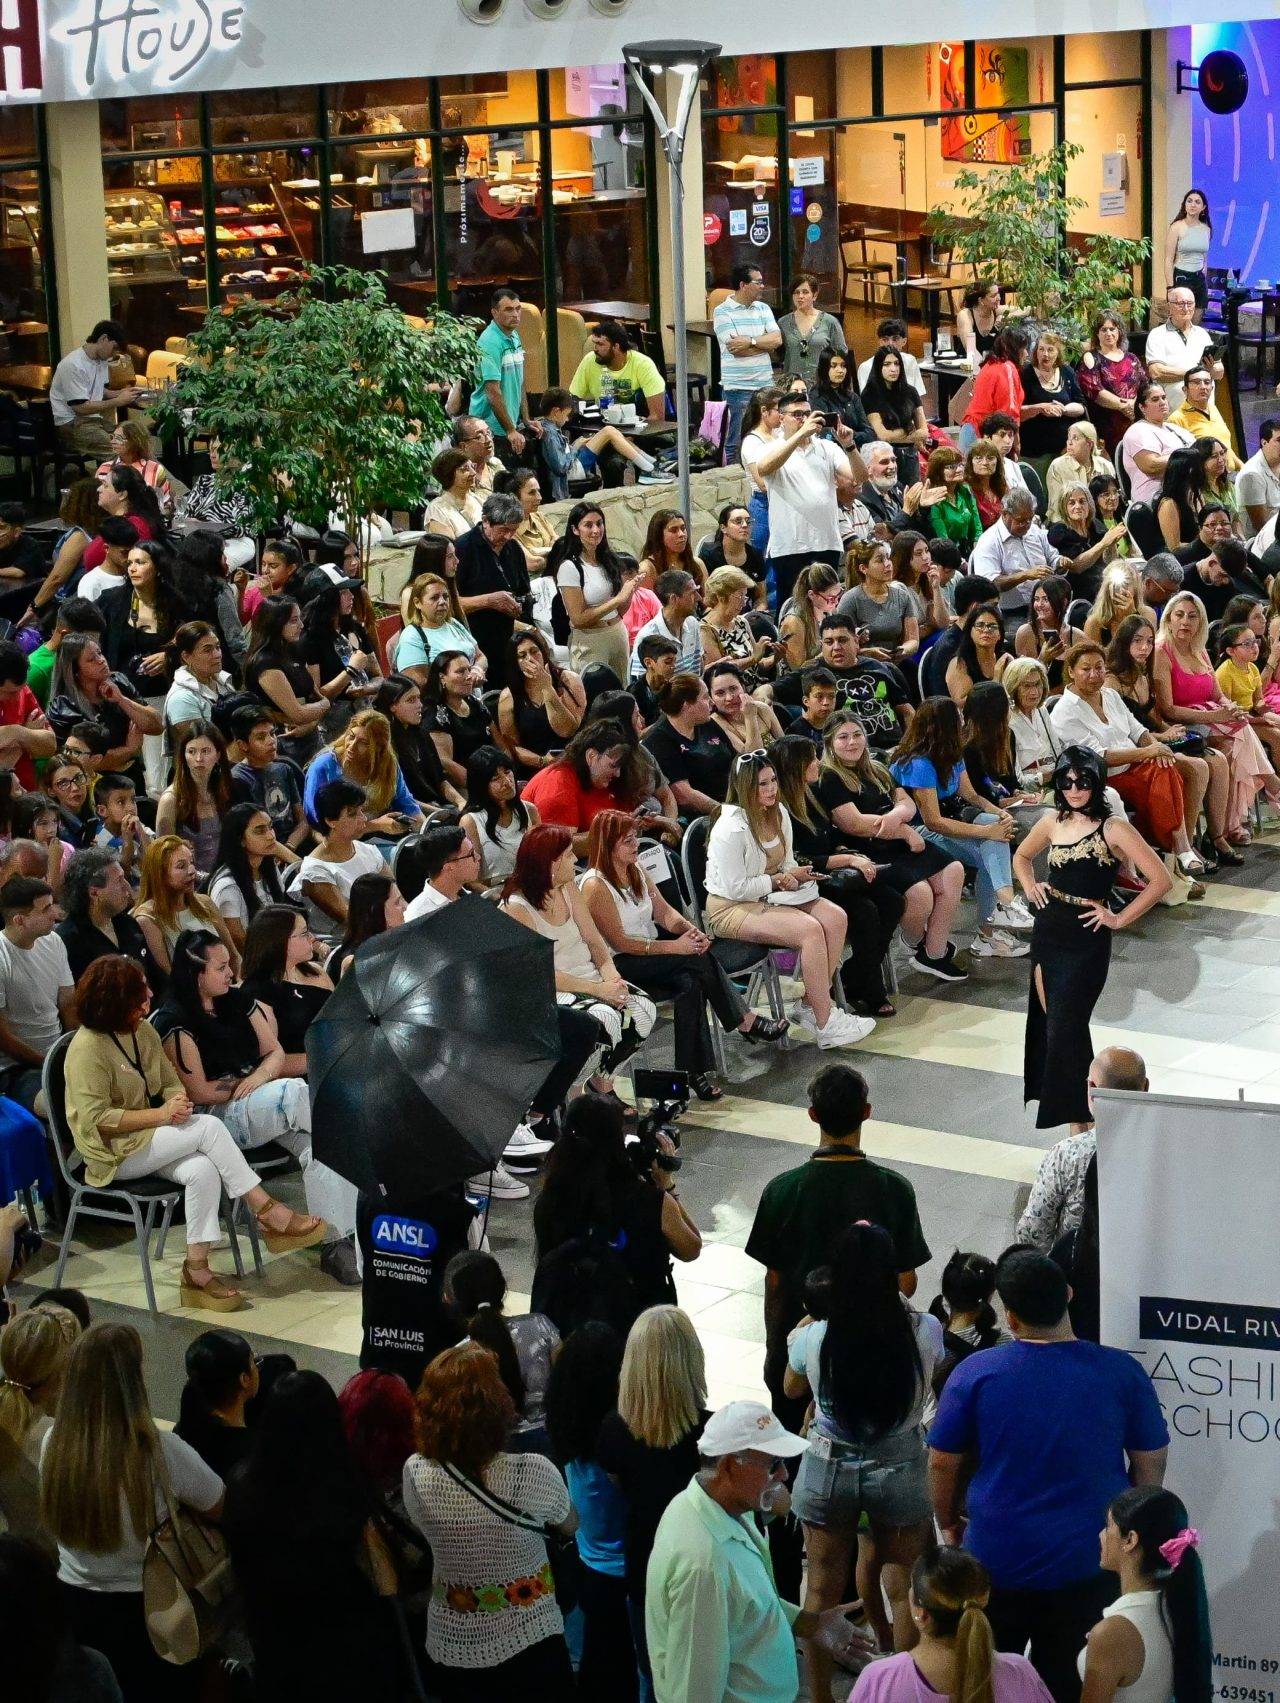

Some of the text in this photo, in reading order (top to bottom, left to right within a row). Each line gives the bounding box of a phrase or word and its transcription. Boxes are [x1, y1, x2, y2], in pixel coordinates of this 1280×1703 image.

[376, 1221, 429, 1248] ANSL
[373, 1259, 432, 1276] COMUNICACIÓN
[376, 1269, 428, 1285] DE GOBIERNO
[1157, 1310, 1236, 1334] VIDAL
[374, 1327, 425, 1343] SAN LUIS
[374, 1338, 424, 1352] La Provincia
[1211, 1653, 1257, 1671] Martin
